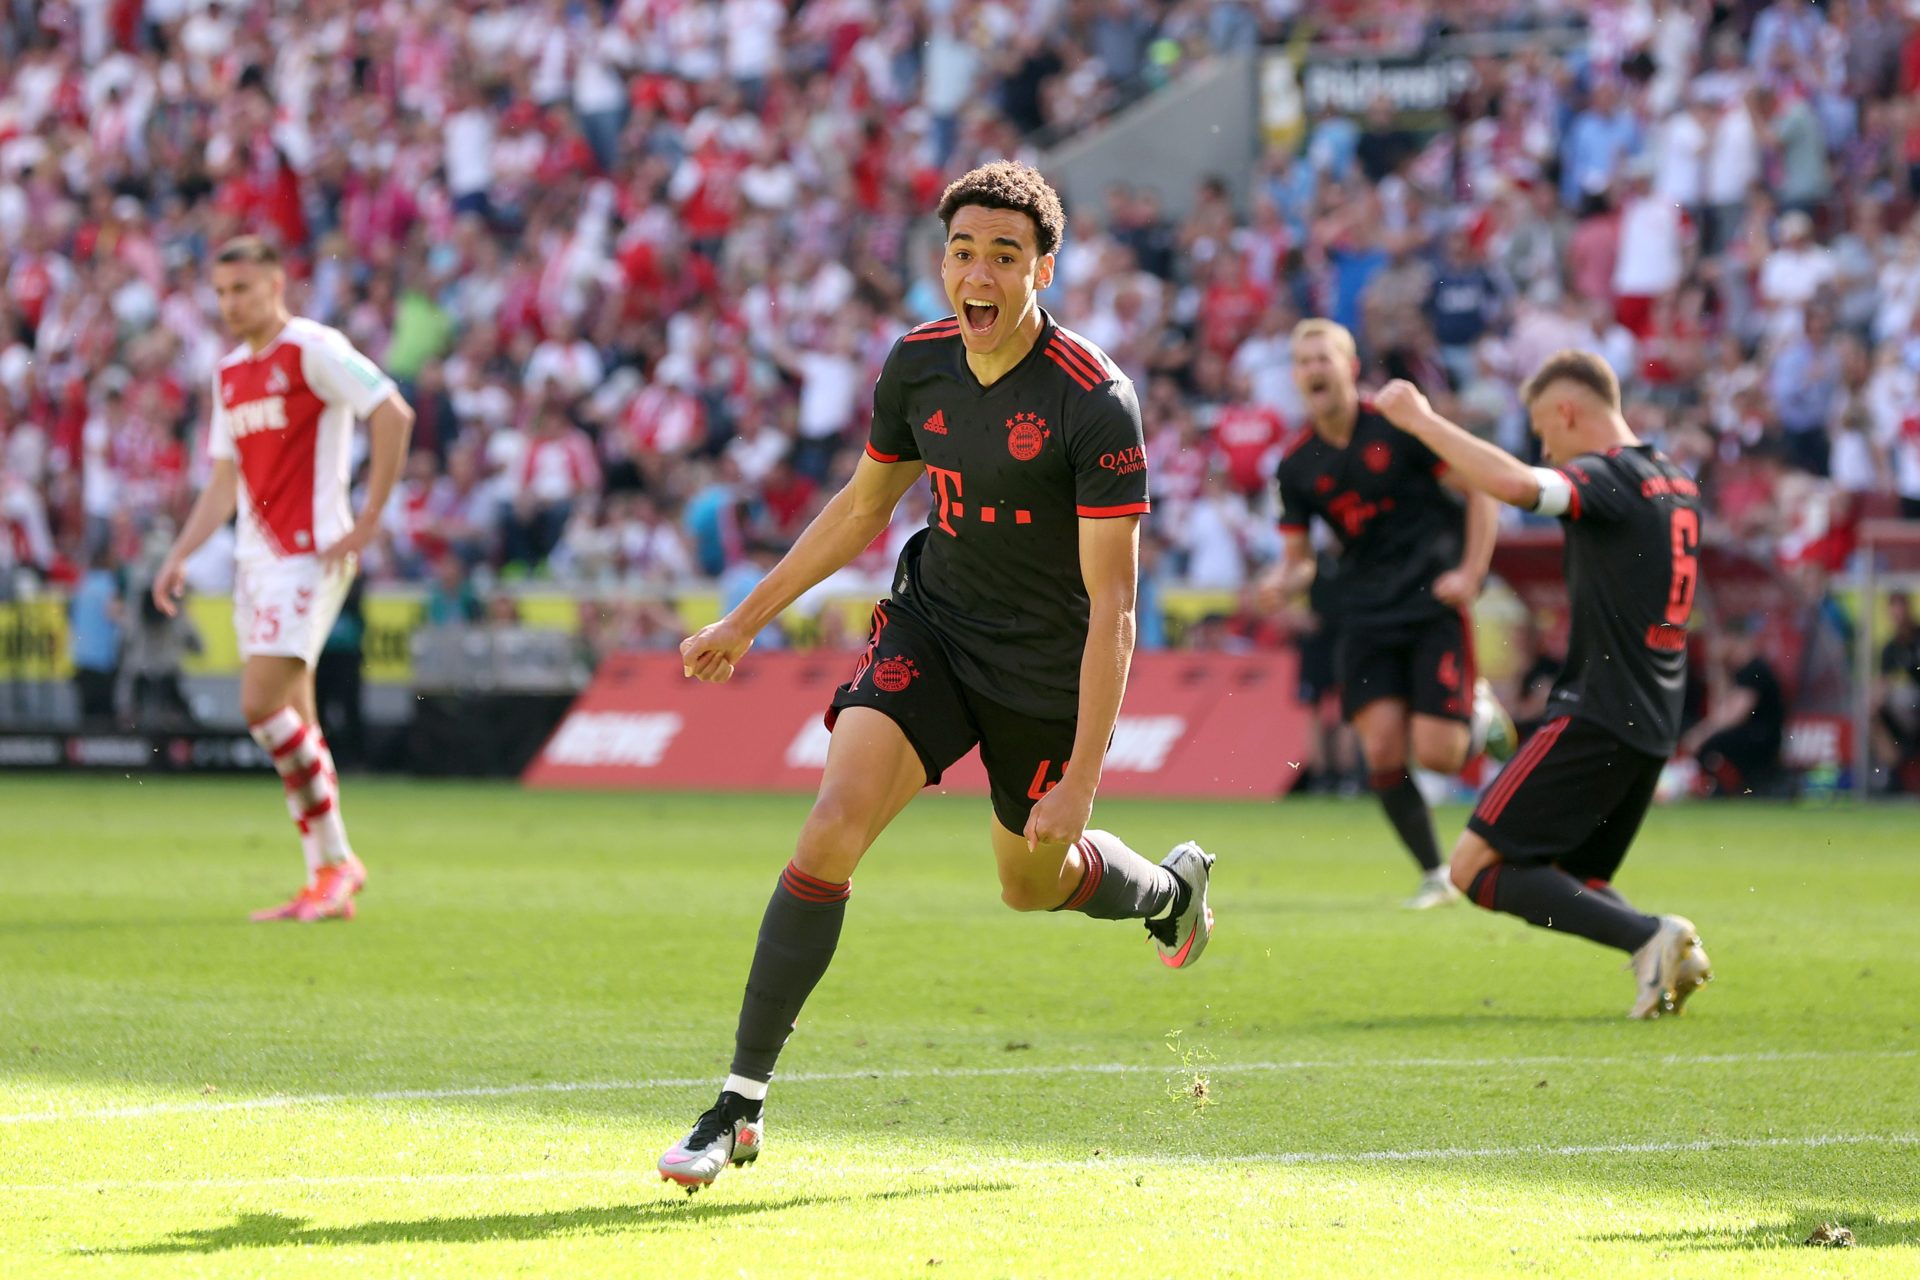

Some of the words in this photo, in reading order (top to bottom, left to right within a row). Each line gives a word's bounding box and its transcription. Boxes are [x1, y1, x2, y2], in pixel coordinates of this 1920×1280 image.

[923, 422, 948, 435] adidas
[1664, 507, 1699, 625] 6
[544, 711, 684, 768] REWE
[1027, 759, 1070, 801] 4
